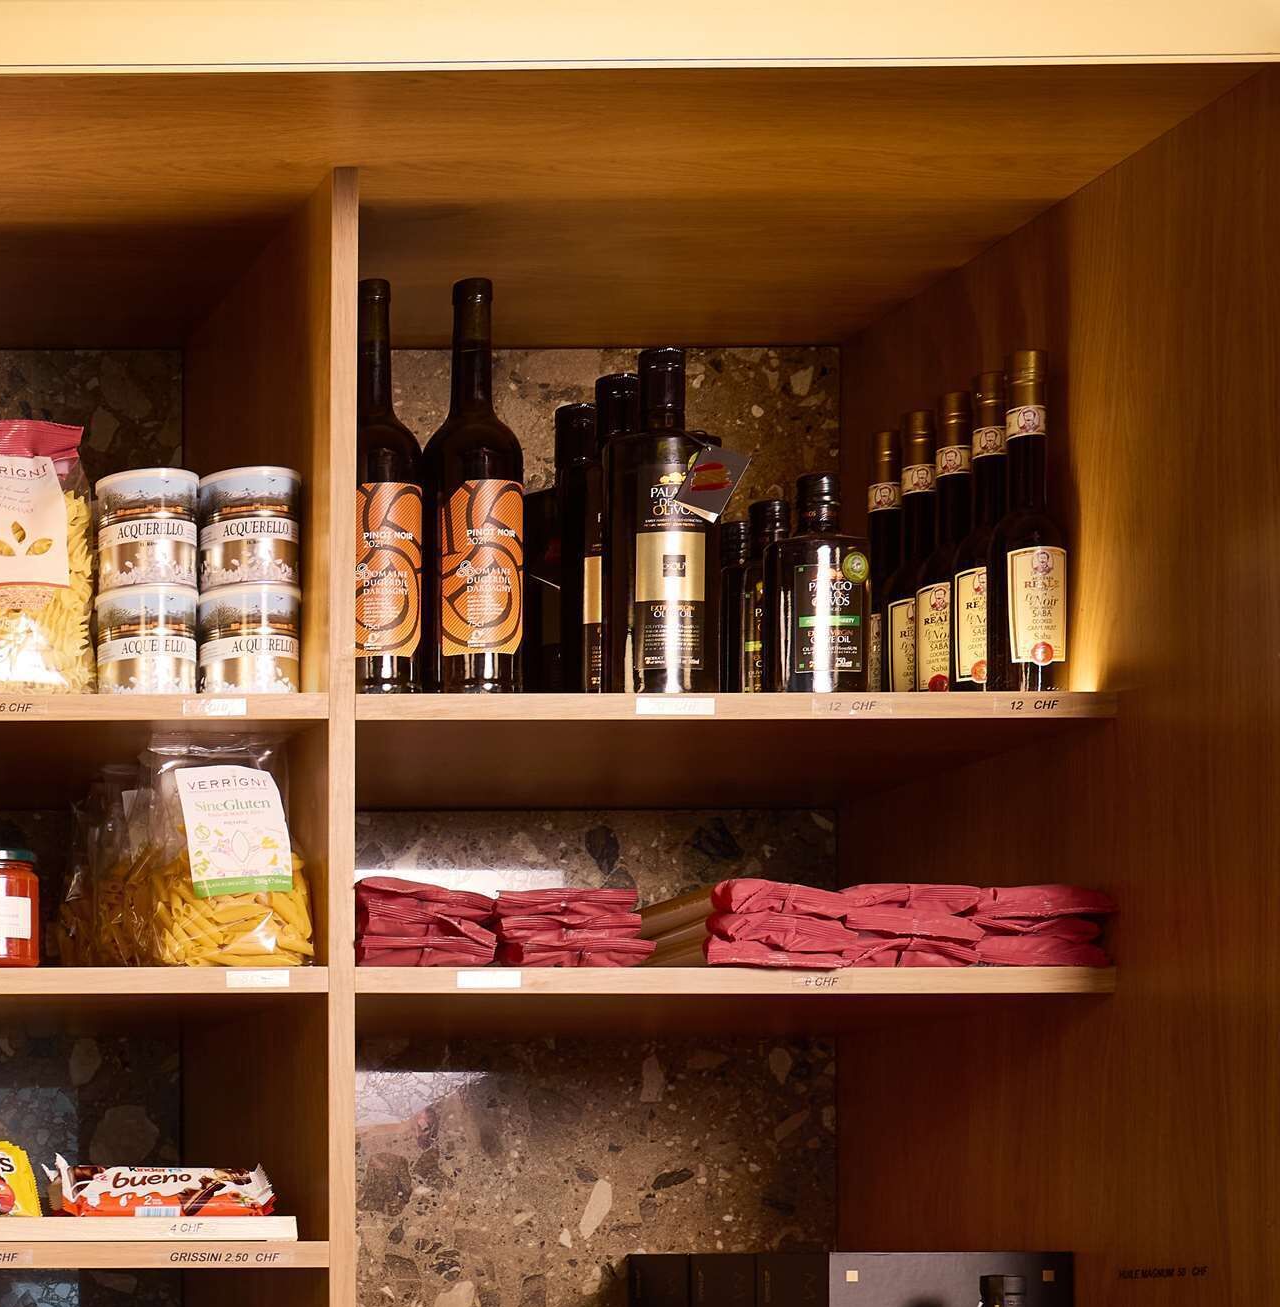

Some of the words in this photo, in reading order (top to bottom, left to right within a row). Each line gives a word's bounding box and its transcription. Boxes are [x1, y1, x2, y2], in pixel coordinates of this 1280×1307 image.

[117, 522, 184, 539] ACQUERELLO
[223, 520, 289, 537] ACQUERELLO
[497, 529, 516, 538] NOIR
[394, 531, 414, 541] NOIR
[467, 537, 488, 545] 2021
[364, 540, 385, 549] 2021
[0, 703, 6, 713] 6
[9, 702, 33, 713] CHF
[828, 702, 841, 711] 12
[852, 701, 877, 711] CHF
[1010, 701, 1024, 710] 12
[1034, 700, 1059, 710] CHF
[187, 777, 269, 791] VERRIGNI
[815, 976, 839, 986] CHF
[112, 1172, 192, 1189] bueno
[144, 1196, 152, 1205] 2
[169, 1224, 176, 1233] 4
[179, 1223, 202, 1233] CHF
[169, 1251, 222, 1262] GRISSINI
[224, 1251, 248, 1262] 2.50
[255, 1251, 280, 1262] CHF
[1192, 1266, 1208, 1277] CHF
